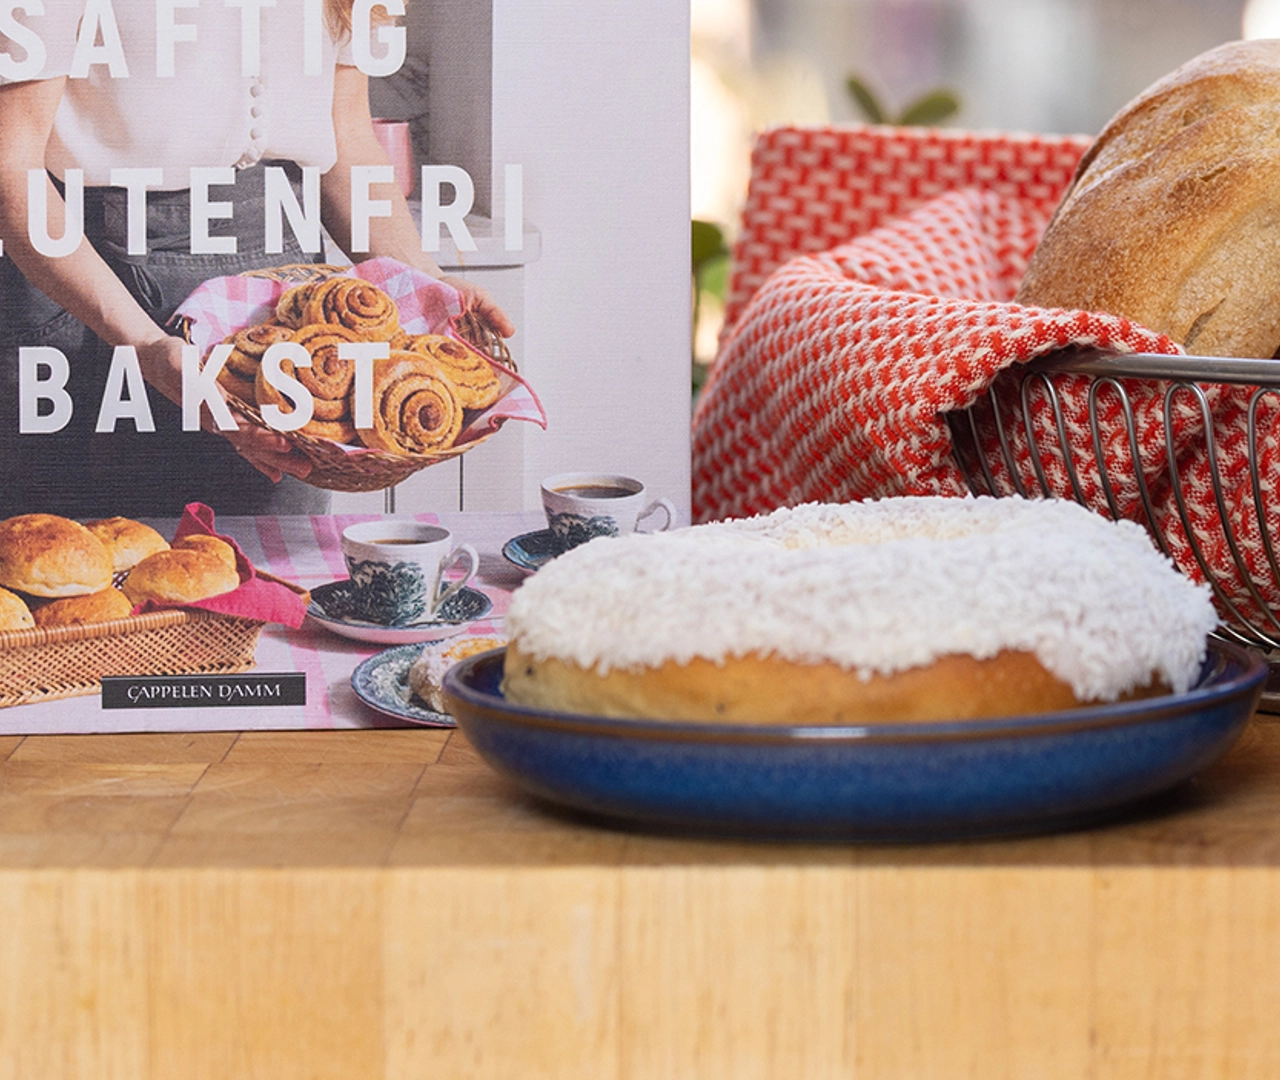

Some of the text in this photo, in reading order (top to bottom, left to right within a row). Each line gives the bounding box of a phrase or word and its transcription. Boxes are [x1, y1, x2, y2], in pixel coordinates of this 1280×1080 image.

[18, 341, 392, 435] BAKST
[126, 683, 281, 703] CAPPELEN DAMM
